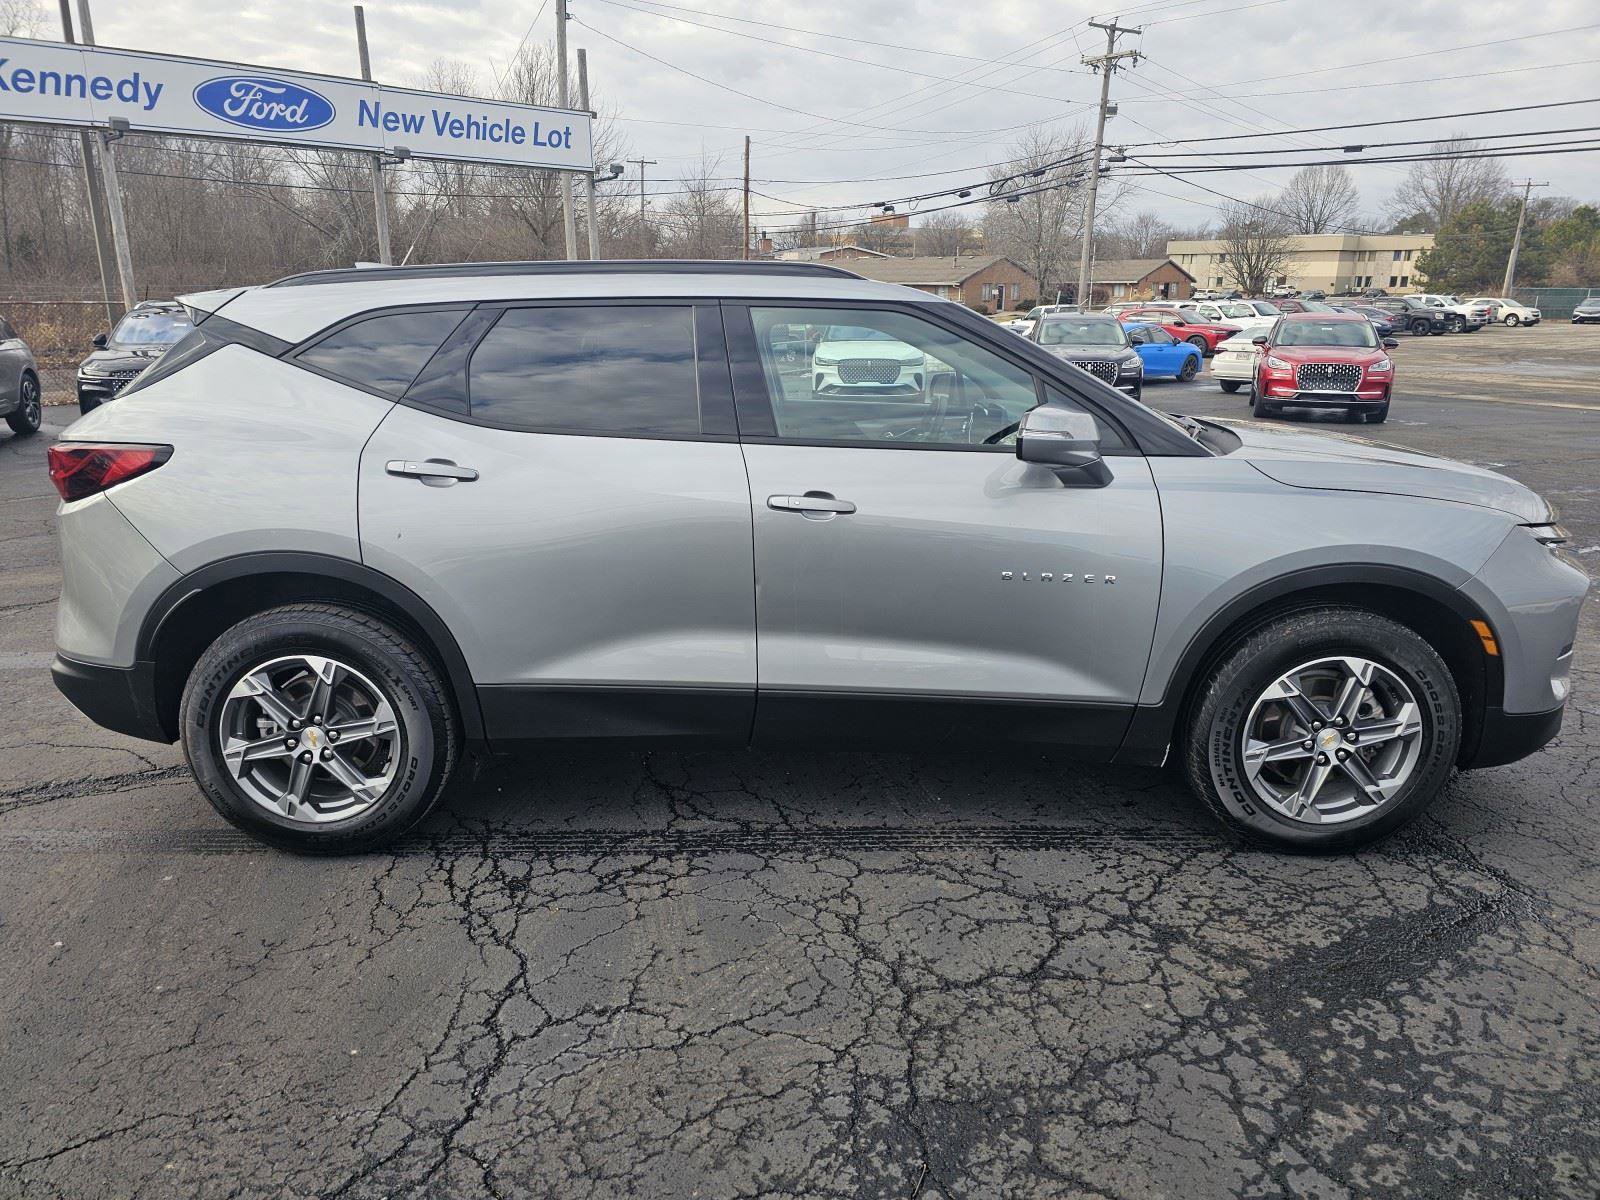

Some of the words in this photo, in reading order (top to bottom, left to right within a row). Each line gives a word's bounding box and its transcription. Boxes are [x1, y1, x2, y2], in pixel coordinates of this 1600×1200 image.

[223, 80, 309, 124] Ford
[358, 99, 425, 134] New
[431, 109, 526, 145] Vehicle
[533, 122, 572, 149] Lot
[1001, 571, 1117, 584] BLAZER
[1415, 671, 1445, 726] CROSS
